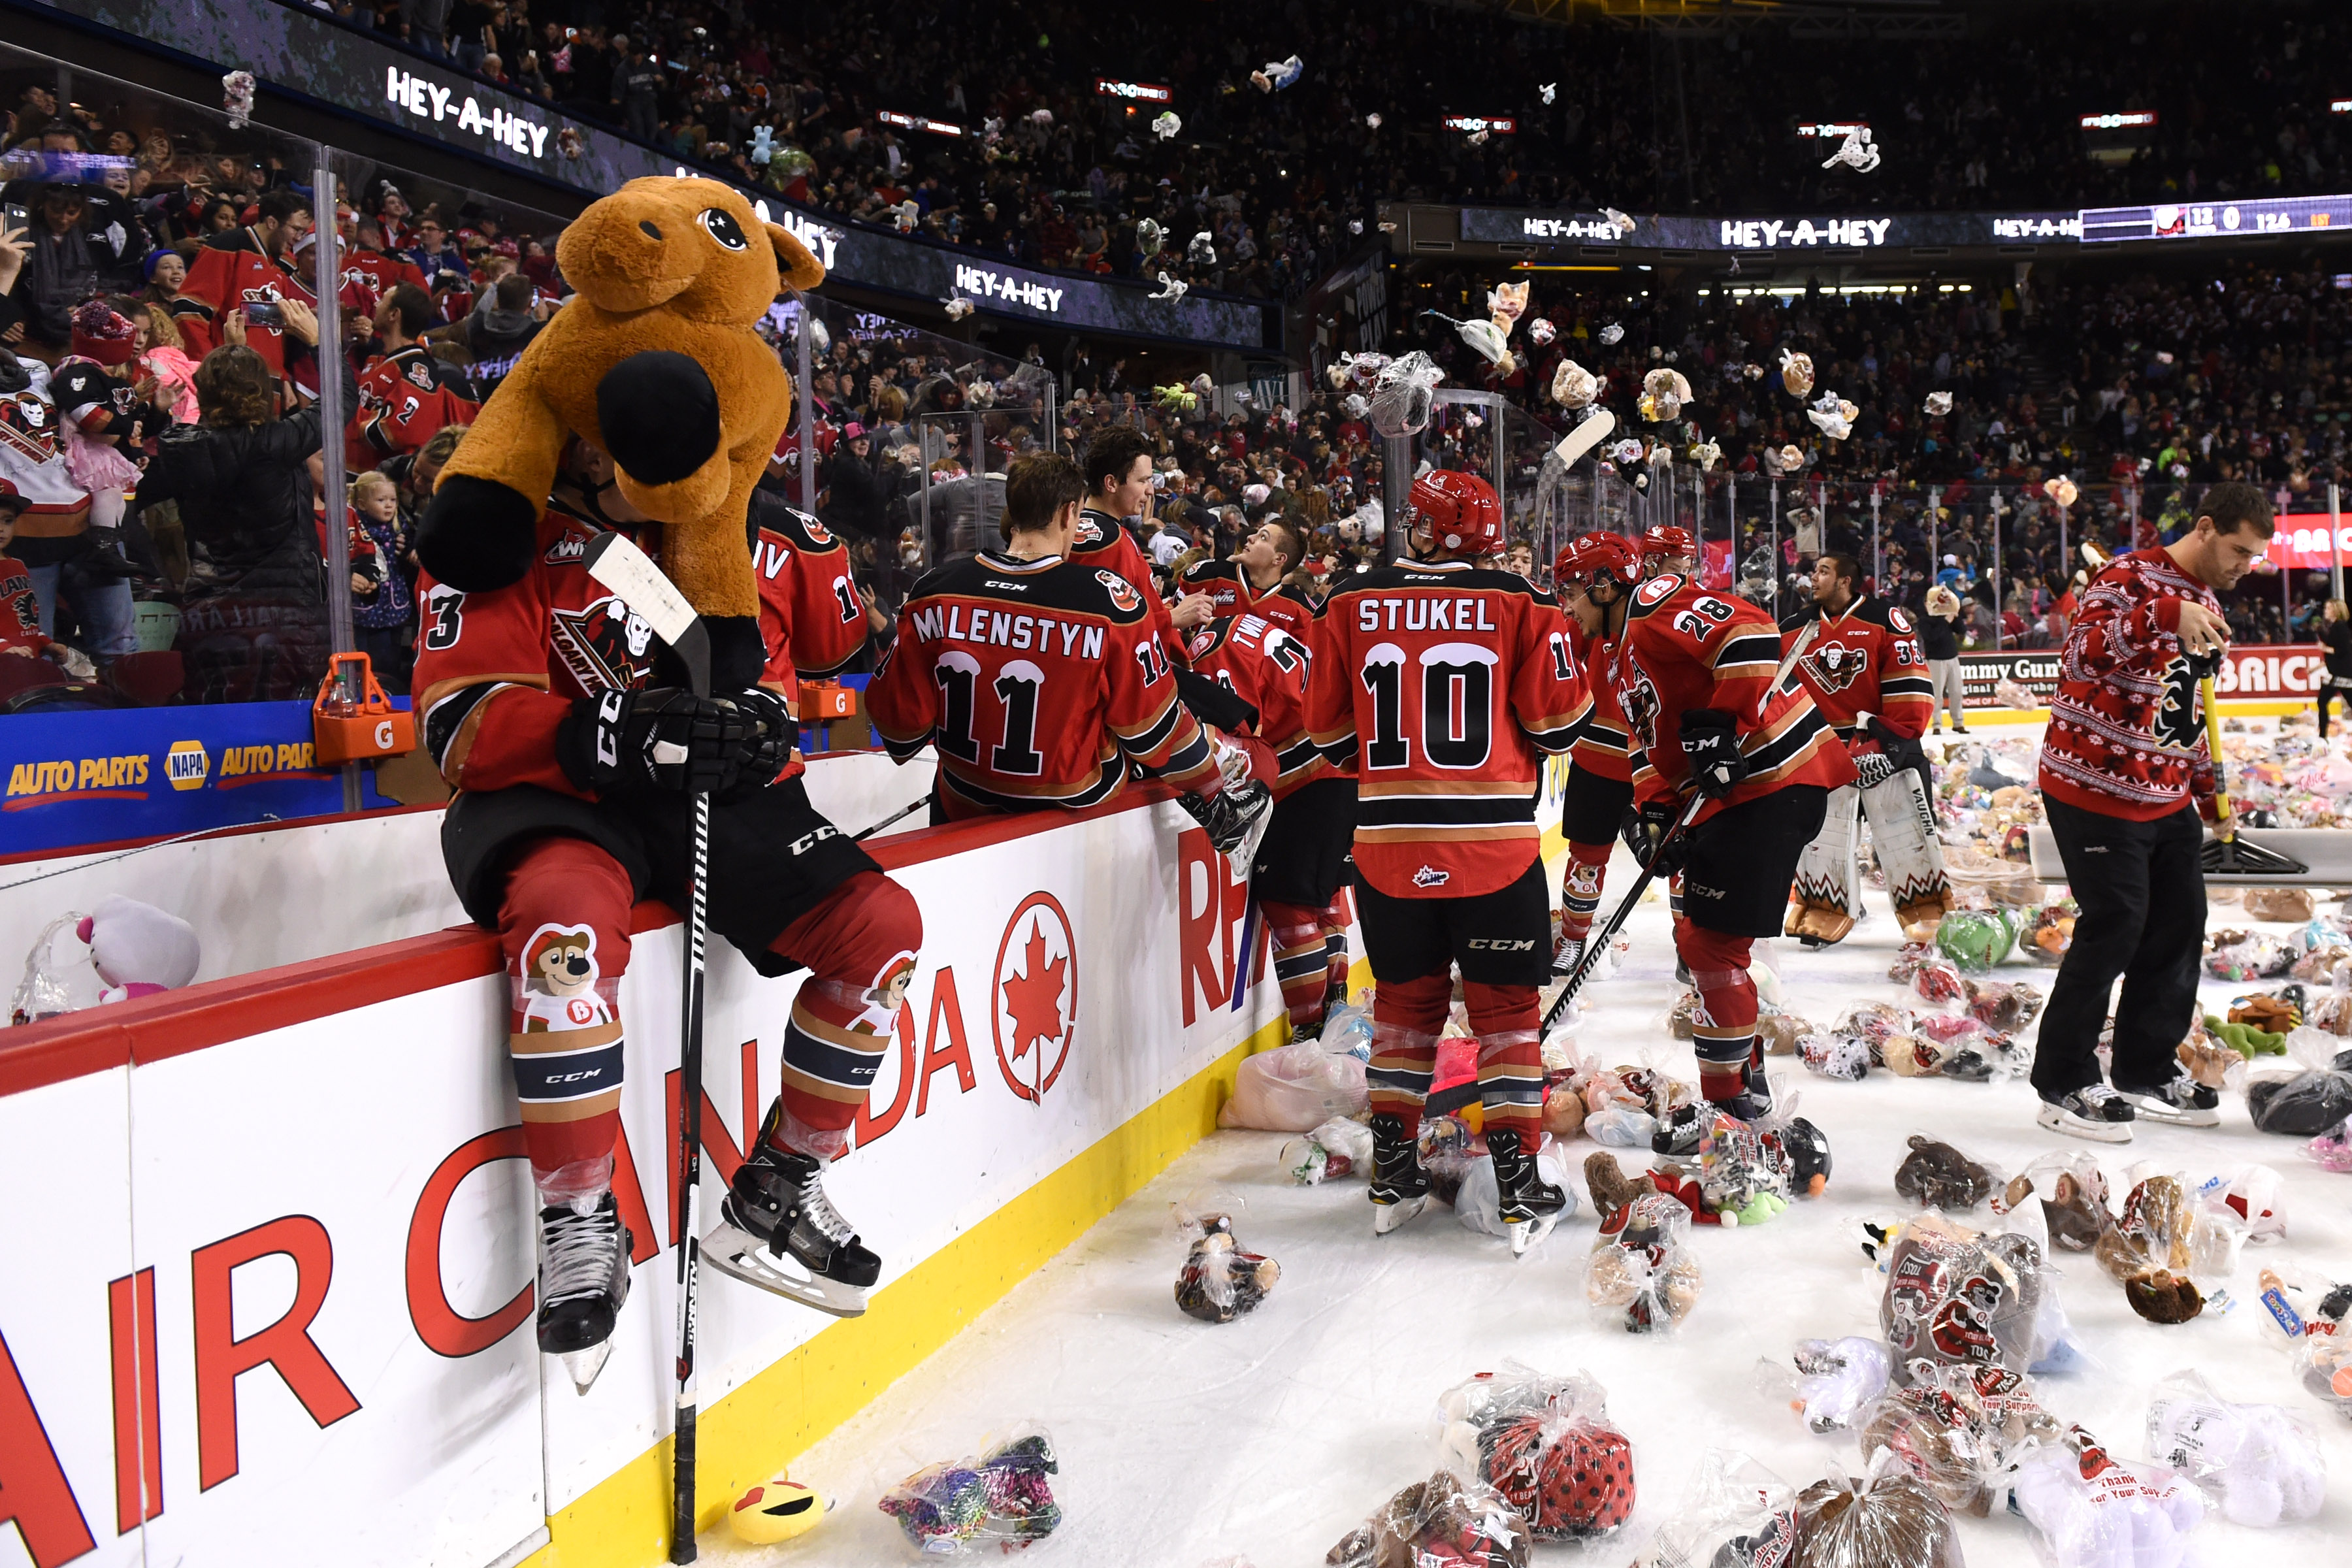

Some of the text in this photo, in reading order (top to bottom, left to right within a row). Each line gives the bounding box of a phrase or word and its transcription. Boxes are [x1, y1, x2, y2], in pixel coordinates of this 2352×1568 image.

[387, 66, 549, 158] HEY-A-HEY
[1524, 218, 1622, 240] HEY-A-HEY
[2223, 206, 2240, 229] 0
[1721, 218, 1891, 247] HEY-A-HEY
[956, 264, 1063, 312] HEY-A-HEY
[397, 397, 419, 425] 2
[1486, 523, 1495, 536] 10
[985, 580, 1028, 591] CCM
[1213, 594, 1235, 602] WHL
[1646, 580, 1673, 598] B
[1269, 611, 1294, 621] CCM
[1360, 599, 1495, 632] STUKEL
[1674, 596, 1735, 644] 28
[912, 606, 1104, 660] MALENSTYN
[1135, 630, 1169, 689] 11
[1894, 640, 1924, 666] 33
[1630, 655, 1646, 683] A
[2014, 659, 2063, 679] Gun'
[836, 693, 845, 713] G
[934, 651, 1045, 776] 11
[1360, 642, 1499, 770] 10
[375, 721, 393, 749] G
[172, 753, 204, 777] NAPA
[220, 742, 314, 776] AUTO PAR
[7, 755, 150, 796] AUTO PARTS
[1912, 788, 1935, 836] VAUGHN
[787, 826, 844, 855] CC
[1468, 939, 1535, 951] CCM
[1552, 938, 1610, 1021] WARRIOR
[572, 1002, 589, 1021] B
[546, 1068, 602, 1083] CCM
[405, 966, 976, 1358] CNDA
[692, 1158, 697, 1171] HD
[1767, 1150, 1778, 1172] TOSS
[1901, 1262, 1921, 1275] TOSS
[688, 1261, 697, 1346] DYNASTY
[1982, 1400, 2001, 1409] Your
[2099, 1475, 2136, 1487] Thank
[2111, 1489, 2136, 1498] Your
